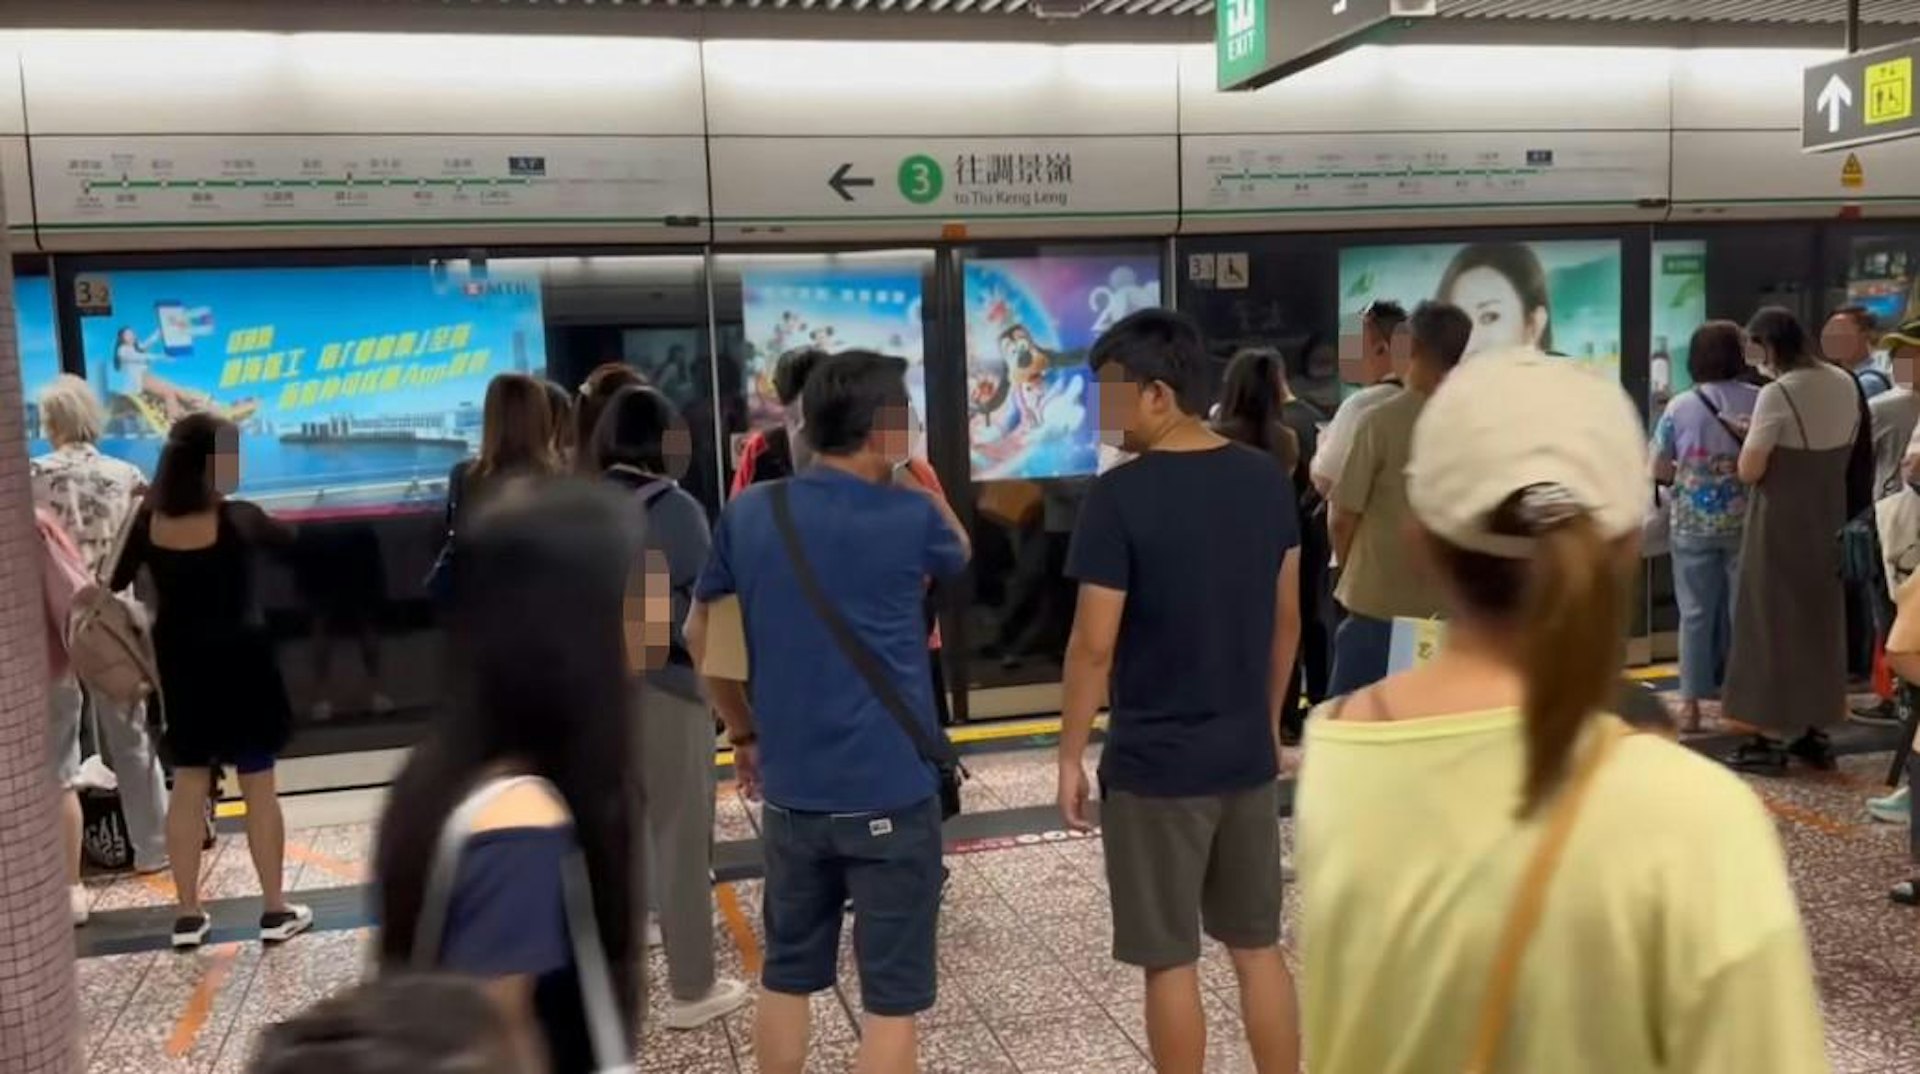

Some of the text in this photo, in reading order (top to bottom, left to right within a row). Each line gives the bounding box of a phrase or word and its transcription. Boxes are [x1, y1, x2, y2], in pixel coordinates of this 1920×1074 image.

[1228, 29, 1254, 61] EXIT
[911, 163, 930, 195] 3
[954, 153, 1071, 185] 往調景嶺
[955, 191, 1068, 207] to Tiu Keng Leng
